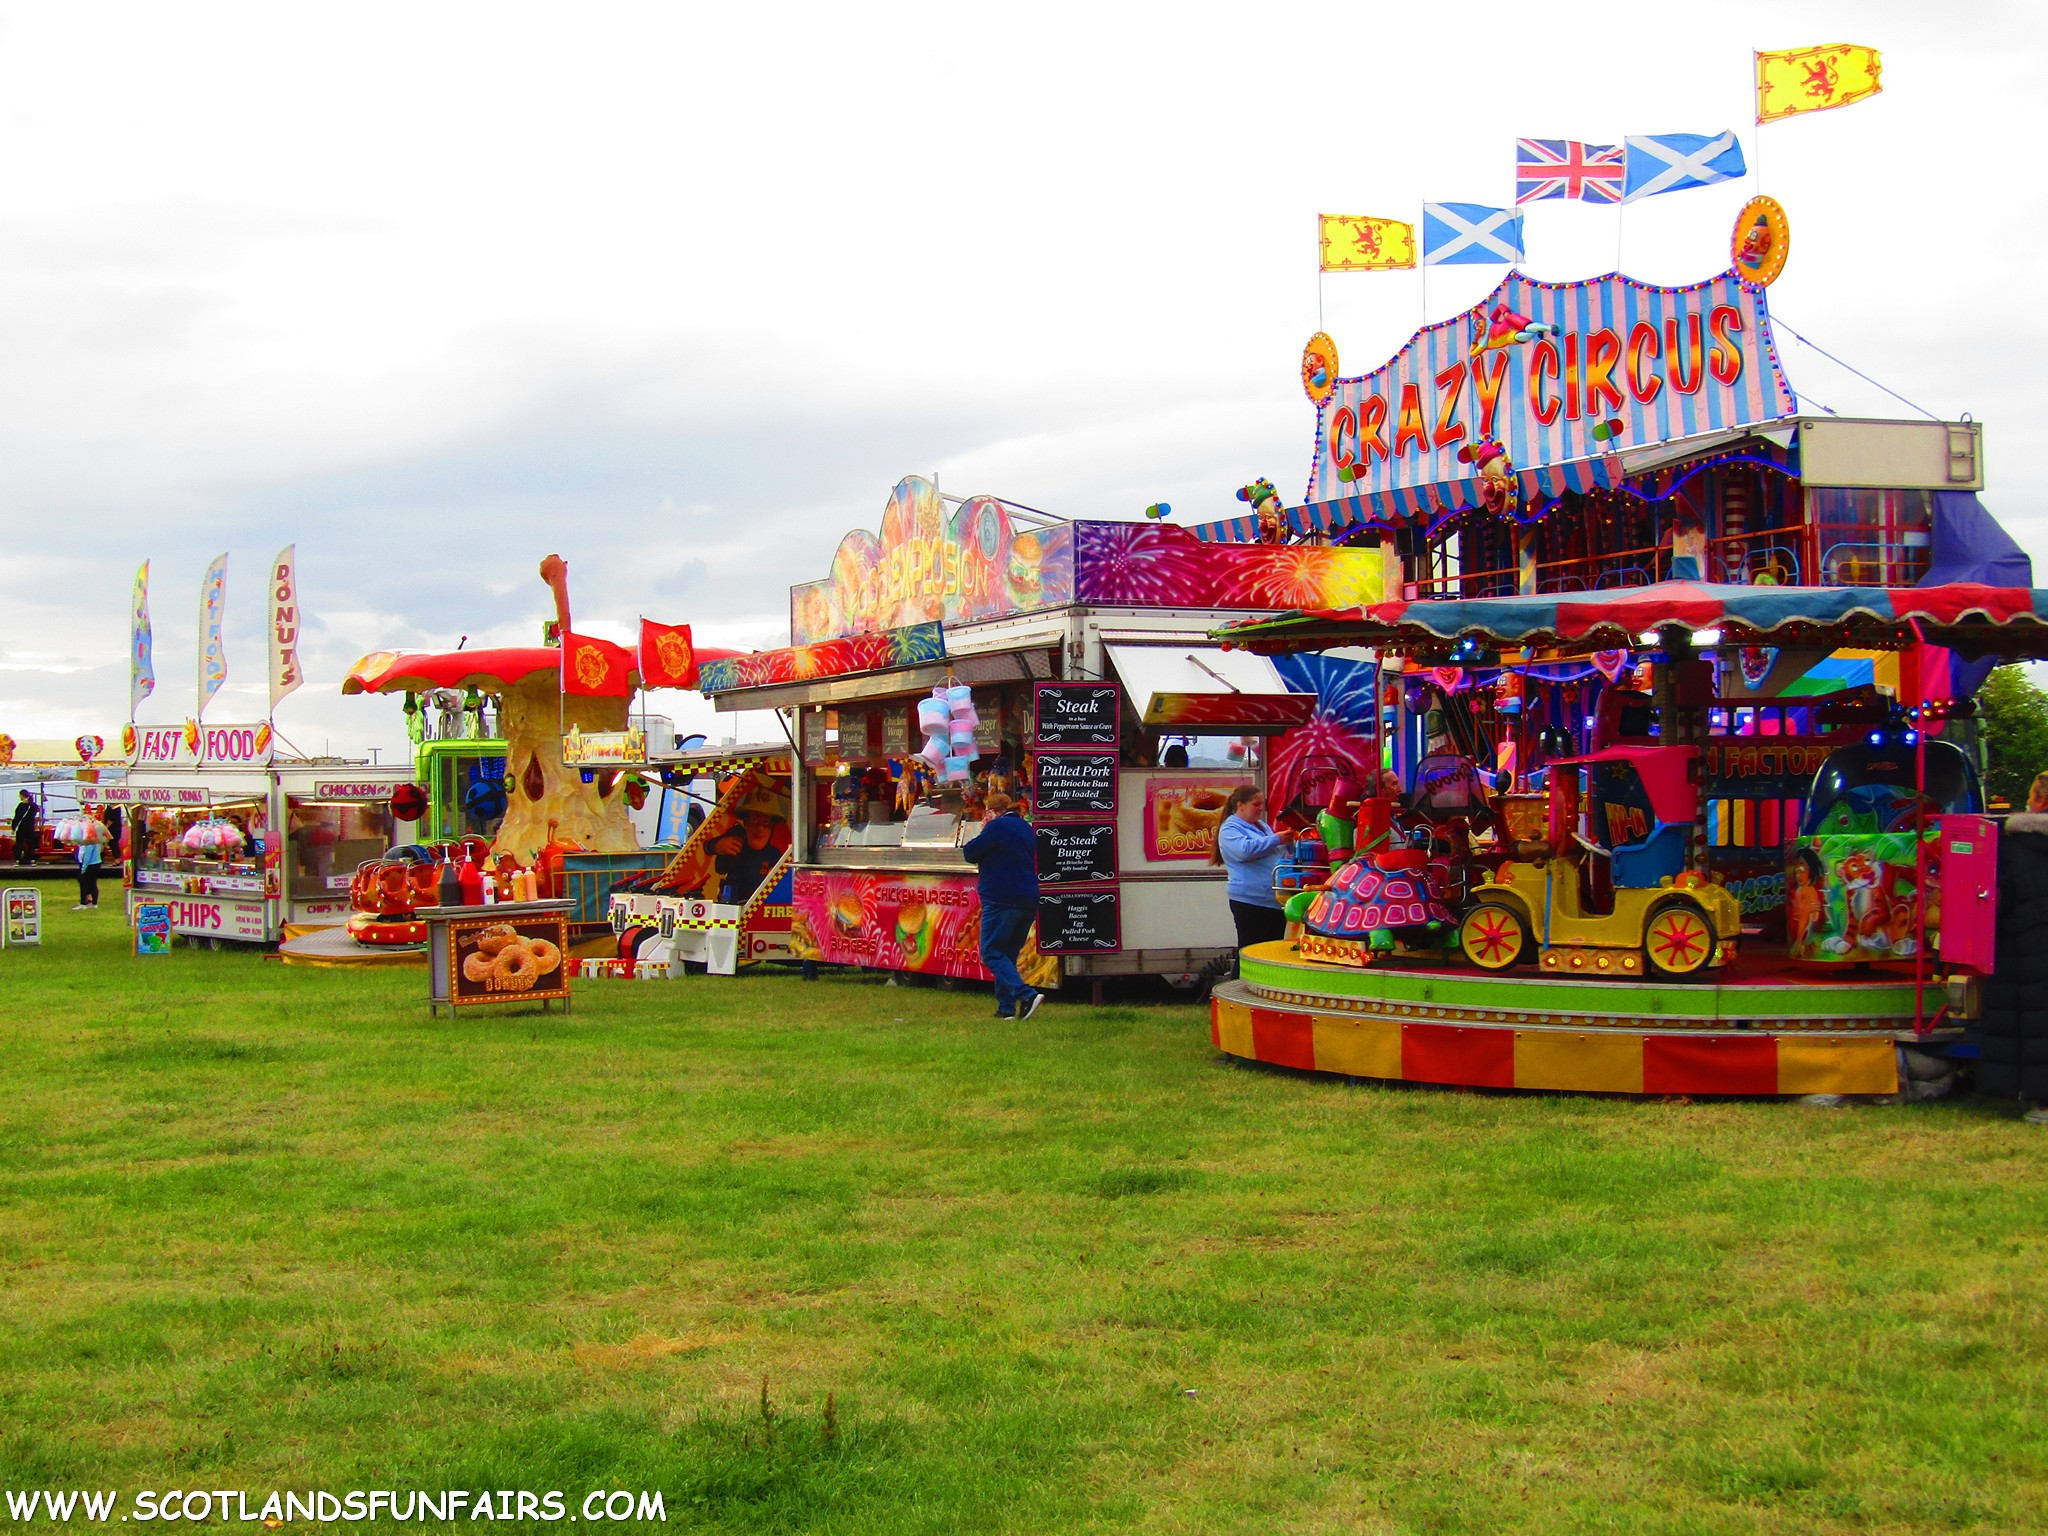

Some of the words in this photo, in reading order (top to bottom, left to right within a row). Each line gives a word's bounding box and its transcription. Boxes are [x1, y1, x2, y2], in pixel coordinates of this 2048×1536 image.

[1331, 350, 1508, 470] CRAZY
[1529, 304, 1742, 427] CIRCUS
[890, 536, 989, 602] EXPLOSION
[275, 564, 295, 686] DONUTS
[1056, 699, 1099, 713] Steak
[1042, 722, 1053, 730] With
[1053, 722, 1079, 732] Peppercorn
[1079, 722, 1093, 730] Sauce
[1098, 722, 1113, 732] Gravy
[142, 731, 183, 760] FAST
[207, 729, 255, 761] FOOD
[1725, 746, 1841, 778] FACTOR
[1042, 765, 1080, 777] Pulled
[1082, 765, 1110, 777] Pork
[320, 784, 377, 797] CHICKEN
[1060, 779, 1091, 787] Brioche
[82, 787, 98, 800] CHIPS
[105, 788, 131, 801] BURGERS
[139, 789, 151, 800] HOT
[152, 790, 171, 801] DOGS
[178, 791, 203, 802] DRINKS
[1052, 789, 1071, 800] fully
[1072, 789, 1099, 798] loaded
[1604, 801, 1649, 846] HOP-ON
[1050, 836, 1068, 846] 6oz
[1069, 835, 1098, 846] Steak
[1156, 826, 1218, 855] DONU
[1057, 847, 1092, 860] Burger
[799, 880, 826, 896] CHIPS
[874, 886, 916, 902] CHICKEN
[917, 888, 969, 907] BURGERS
[168, 900, 222, 929] CHIPS
[306, 904, 332, 914] CHIPS
[692, 907, 703, 915] £1
[763, 905, 793, 918] FIRE
[1073, 920, 1084, 928] Egg
[830, 936, 878, 956] BURGERS
[938, 947, 959, 964] HOT
[963, 948, 979, 965] DO
[485, 975, 534, 992] DONUTS
